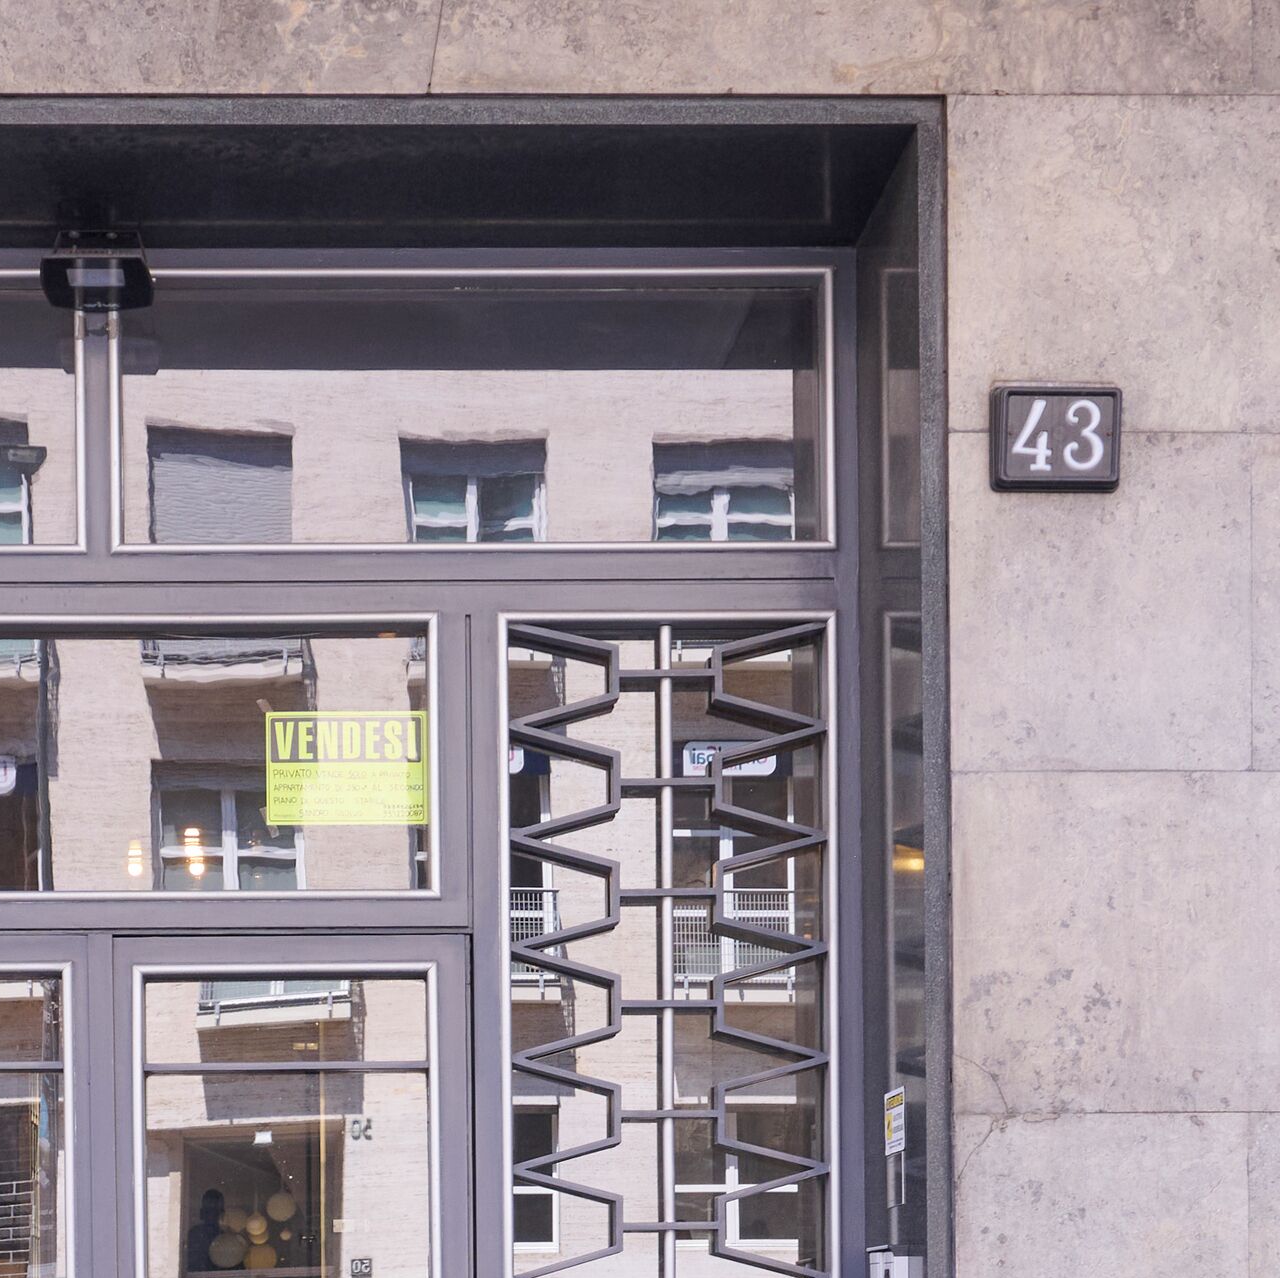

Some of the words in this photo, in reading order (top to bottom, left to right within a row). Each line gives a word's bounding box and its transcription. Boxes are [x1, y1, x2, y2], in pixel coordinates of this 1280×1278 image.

[1012, 398, 1105, 472] 43
[274, 720, 418, 761] VENDESI
[273, 768, 312, 779] PRIVATO
[273, 796, 298, 804] PIANO
